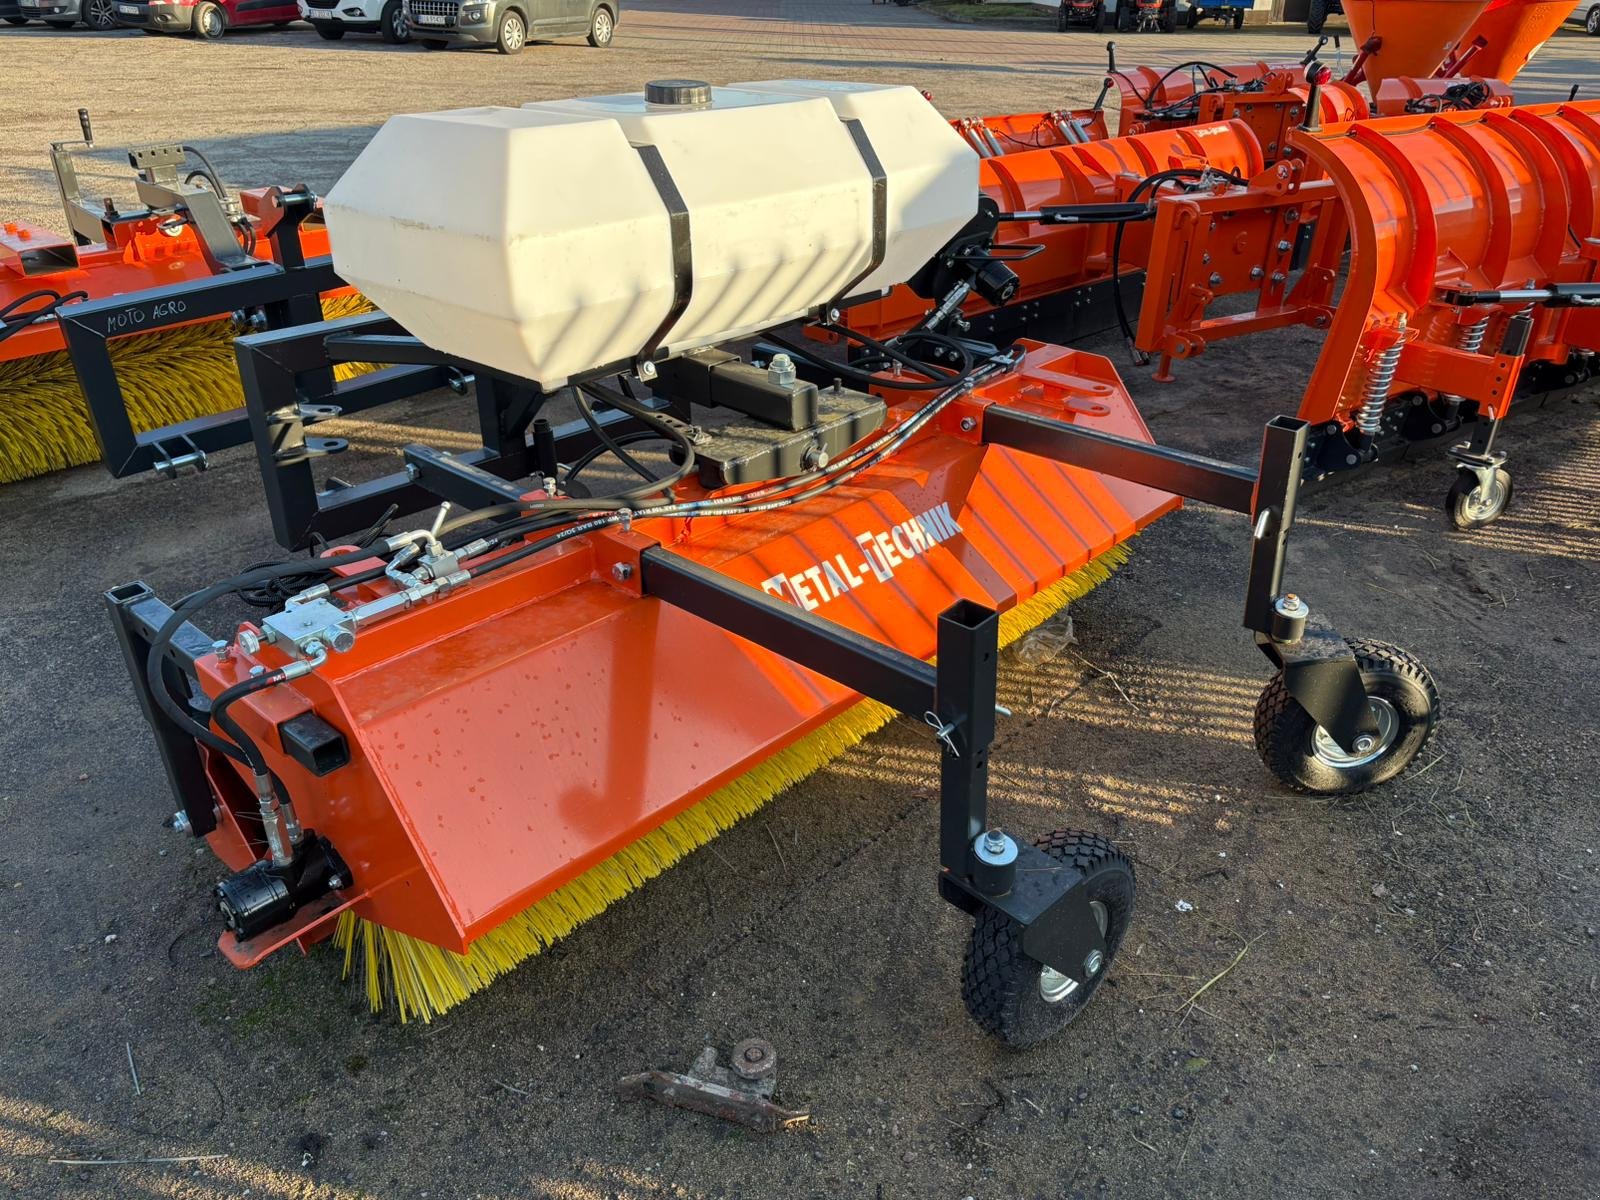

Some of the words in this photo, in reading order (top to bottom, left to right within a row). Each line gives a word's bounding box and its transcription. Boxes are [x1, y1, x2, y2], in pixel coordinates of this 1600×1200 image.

[107, 308, 146, 333] MOTO
[152, 300, 187, 320] AGRO
[577, 522, 593, 531] BAR
